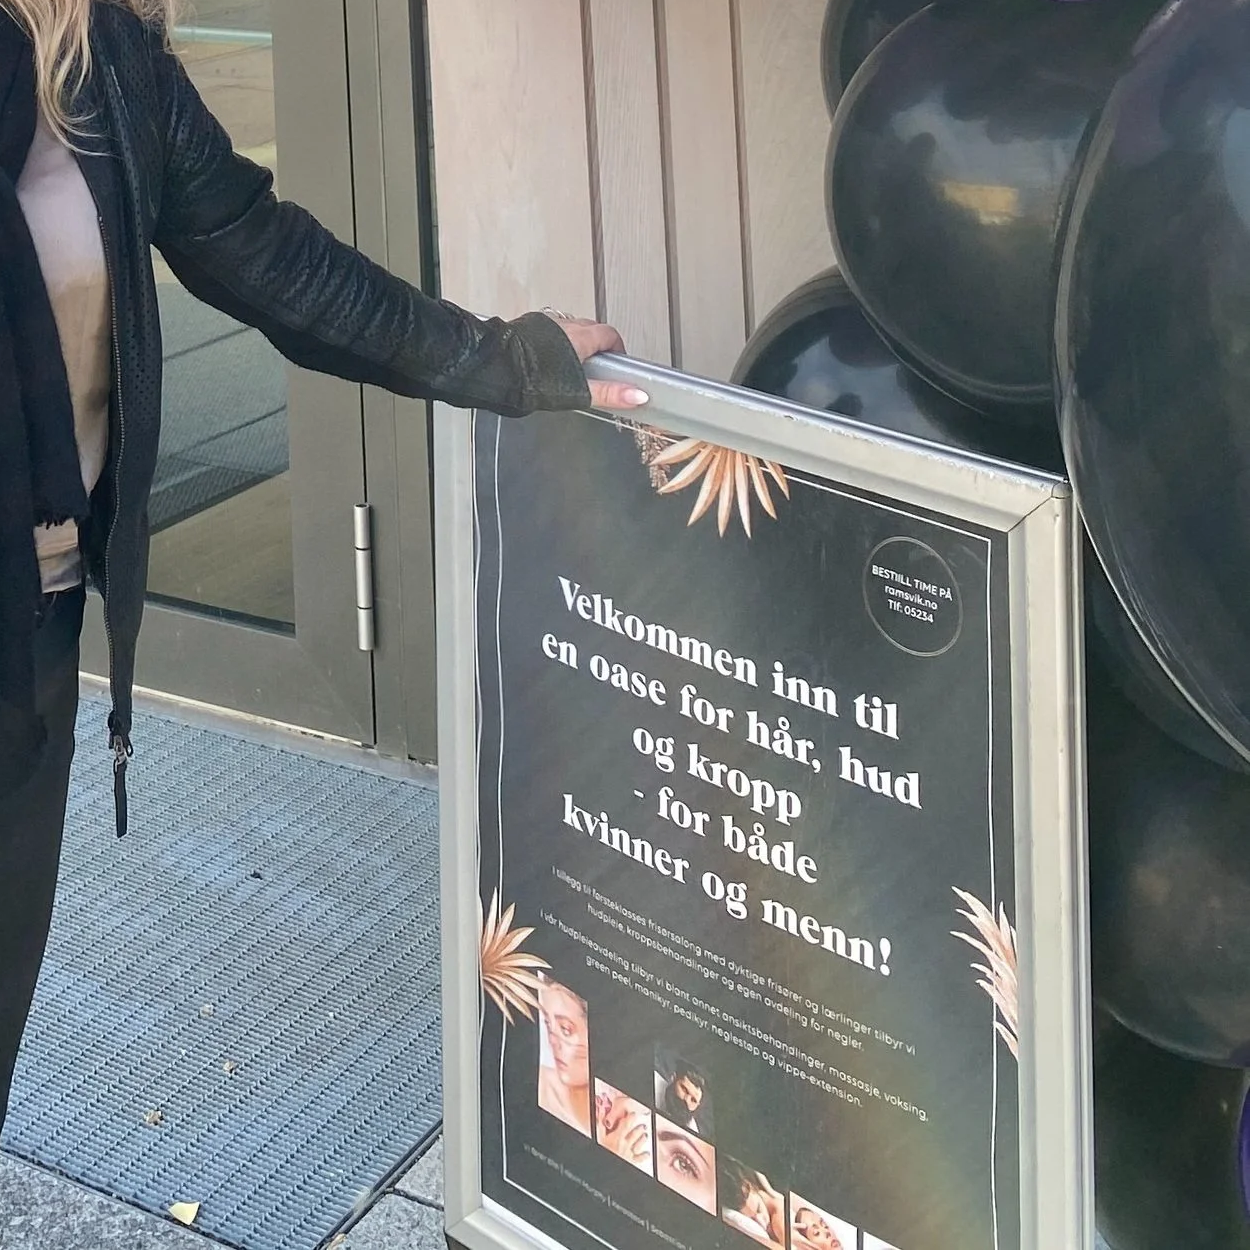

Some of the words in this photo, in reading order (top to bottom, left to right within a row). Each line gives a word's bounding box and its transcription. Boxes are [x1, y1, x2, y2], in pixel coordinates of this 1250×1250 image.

[884, 585, 938, 611] ramsvik.no
[903, 605, 934, 624] 05234
[913, 578, 938, 597] TIME
[939, 587, 953, 602] PÅ
[557, 575, 759, 688] Velkommen
[771, 661, 839, 718] inn
[853, 693, 900, 741] til
[542, 633, 579, 670] en
[589, 654, 667, 706] oase
[679, 684, 735, 734] for
[745, 710, 822, 774] hår,
[838, 746, 923, 810] hud
[632, 727, 675, 773] og
[686, 743, 802, 827] kropp
[562, 793, 690, 884] kvinner
[701, 871, 748, 920] og
[760, 899, 893, 977] menn!
[657, 786, 711, 837] for
[720, 815, 818, 884] både
[558, 919, 630, 971] hudpleieavdeling
[631, 962, 654, 982] tilbyr
[656, 977, 664, 987] vi
[665, 981, 691, 1002] blant
[691, 996, 721, 1018] annet
[722, 1011, 827, 1073] ansiktsbehandlinger,
[829, 1066, 882, 1100] massasje,
[585, 955, 611, 975] green
[762, 1051, 776, 1067] og
[626, 924, 719, 979] kroppsbehandlinger
[721, 976, 735, 991] og
[736, 983, 763, 1002] egen
[764, 996, 808, 1028] avdeling
[810, 1017, 825, 1033] for
[703, 949, 726, 967] med
[728, 960, 765, 985] dyktige
[805, 998, 819, 1014] og
[821, 1004, 872, 1035] lærlinger
[874, 1029, 904, 1050] tilbyr
[905, 1043, 916, 1056] vi
